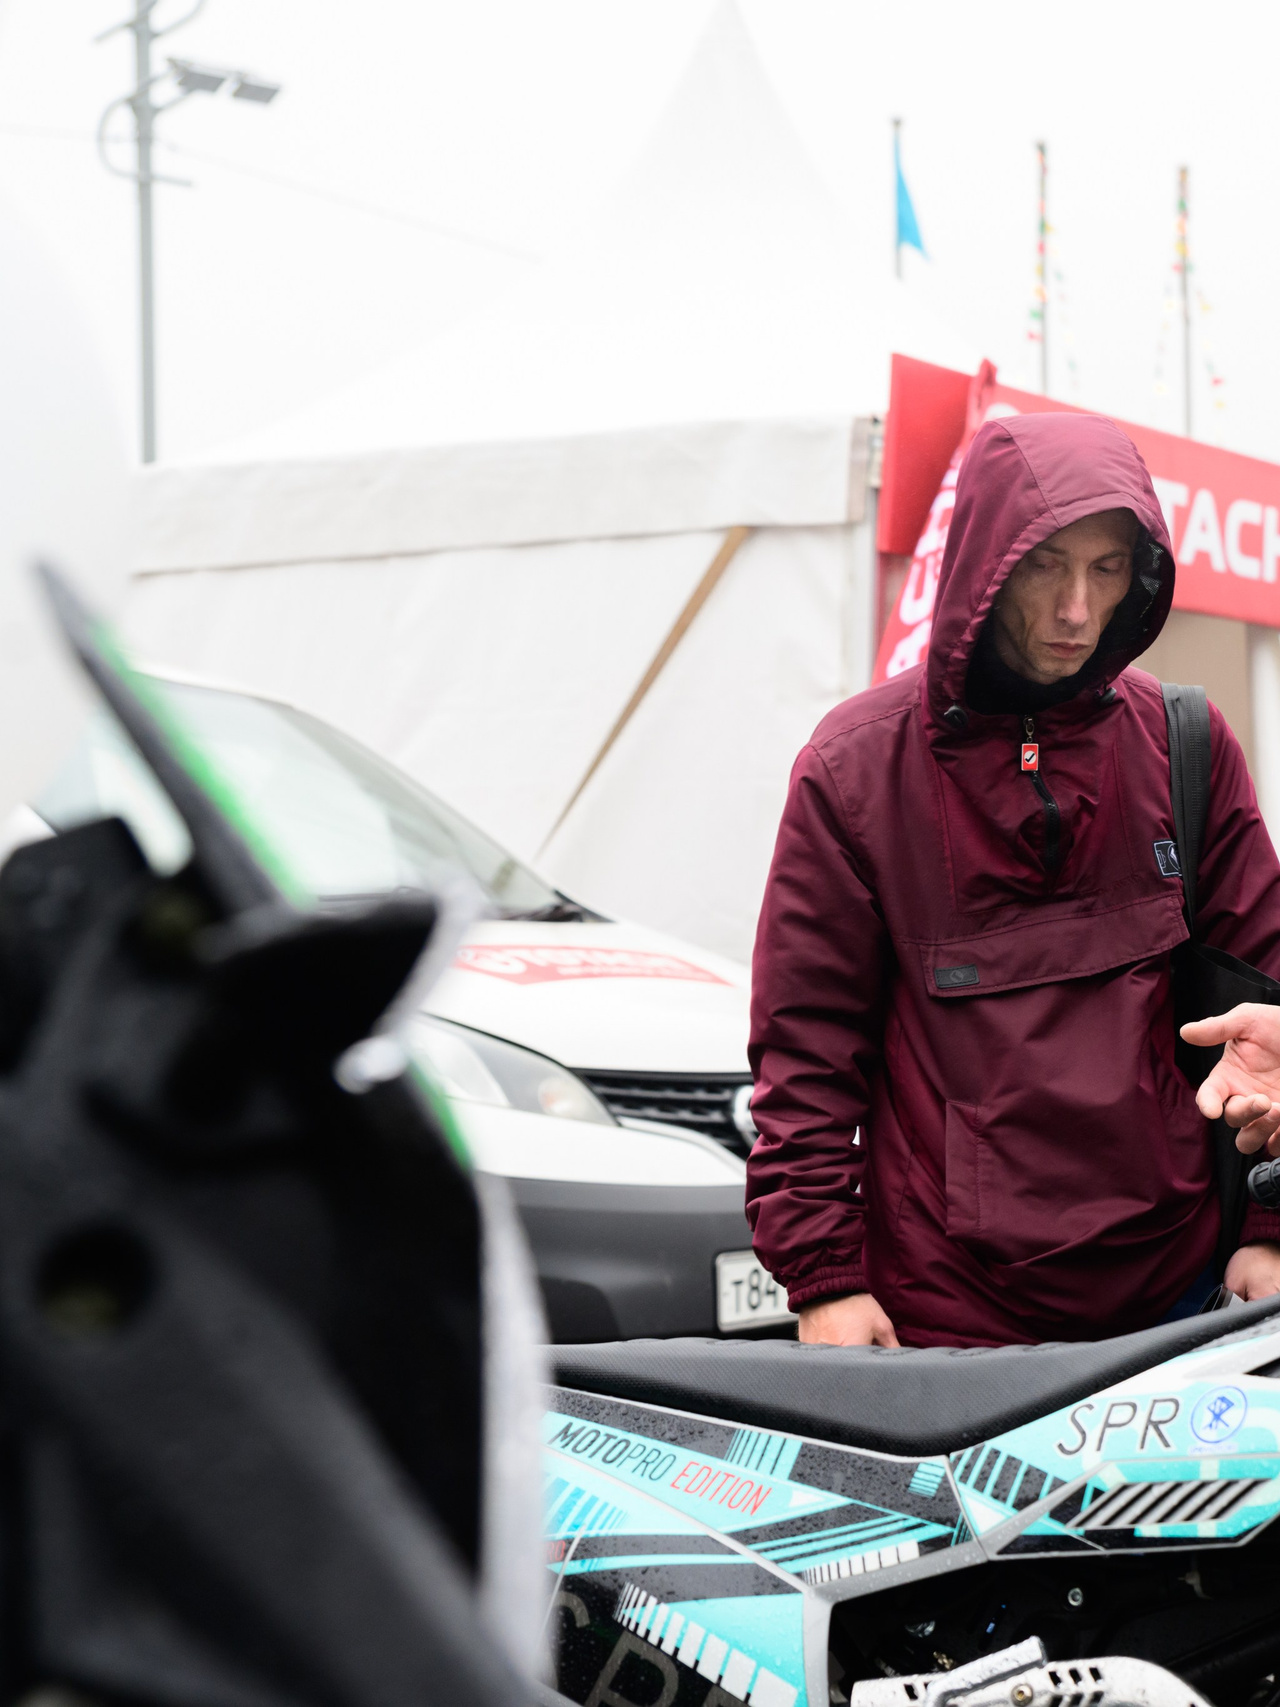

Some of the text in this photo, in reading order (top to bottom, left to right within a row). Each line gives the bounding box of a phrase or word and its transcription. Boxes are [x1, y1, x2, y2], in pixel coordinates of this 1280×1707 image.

[1057, 1397, 1180, 1456] SPR
[547, 1422, 773, 1516] MOTOPRO EDITION
